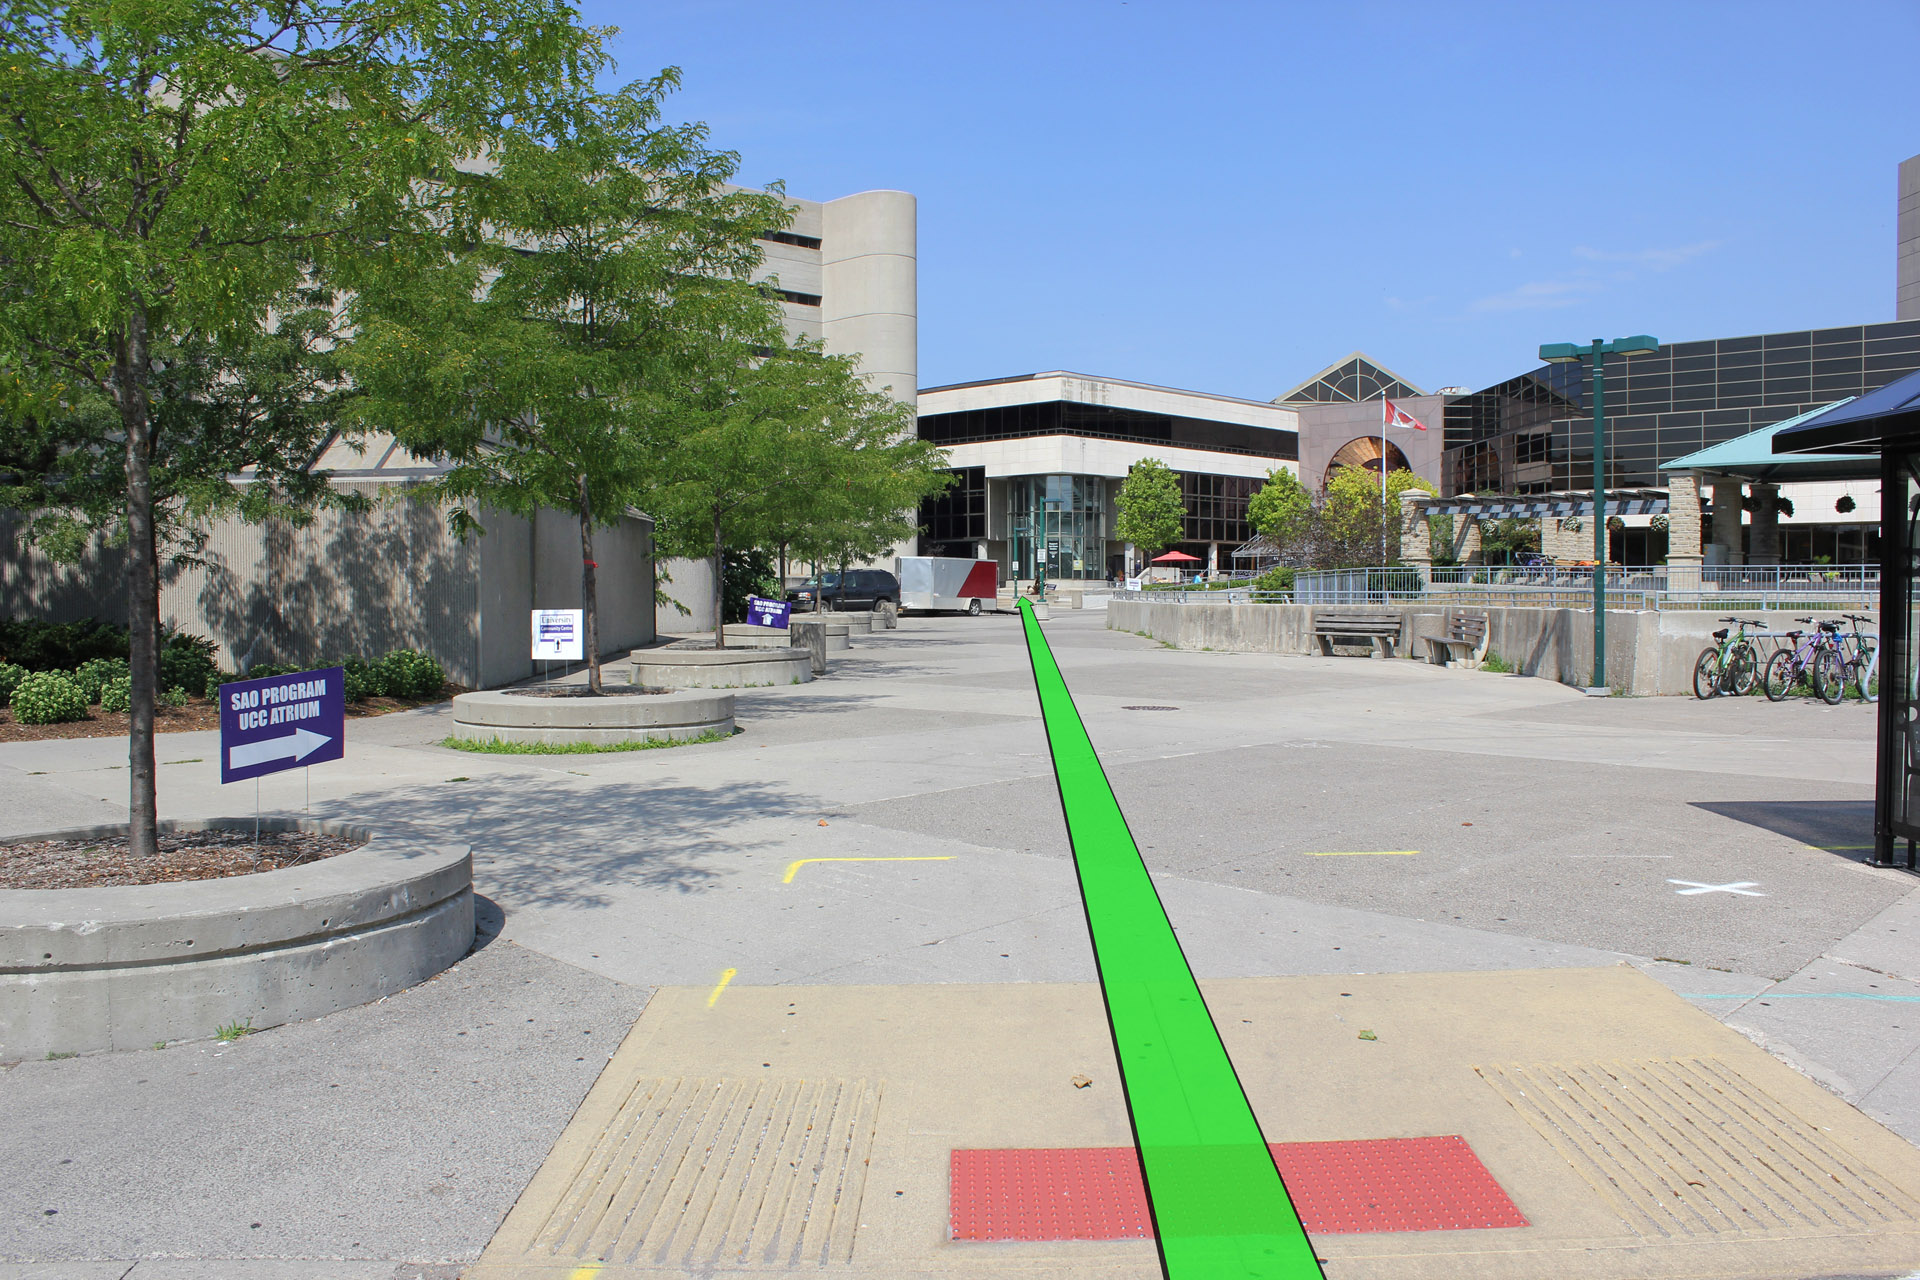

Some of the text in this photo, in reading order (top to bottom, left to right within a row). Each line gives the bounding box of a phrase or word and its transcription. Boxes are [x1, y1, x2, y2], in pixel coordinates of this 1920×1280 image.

[541, 616, 571, 625] University
[231, 679, 326, 711] SAO PROGRAM
[239, 700, 320, 731] UCC ATRIUM
